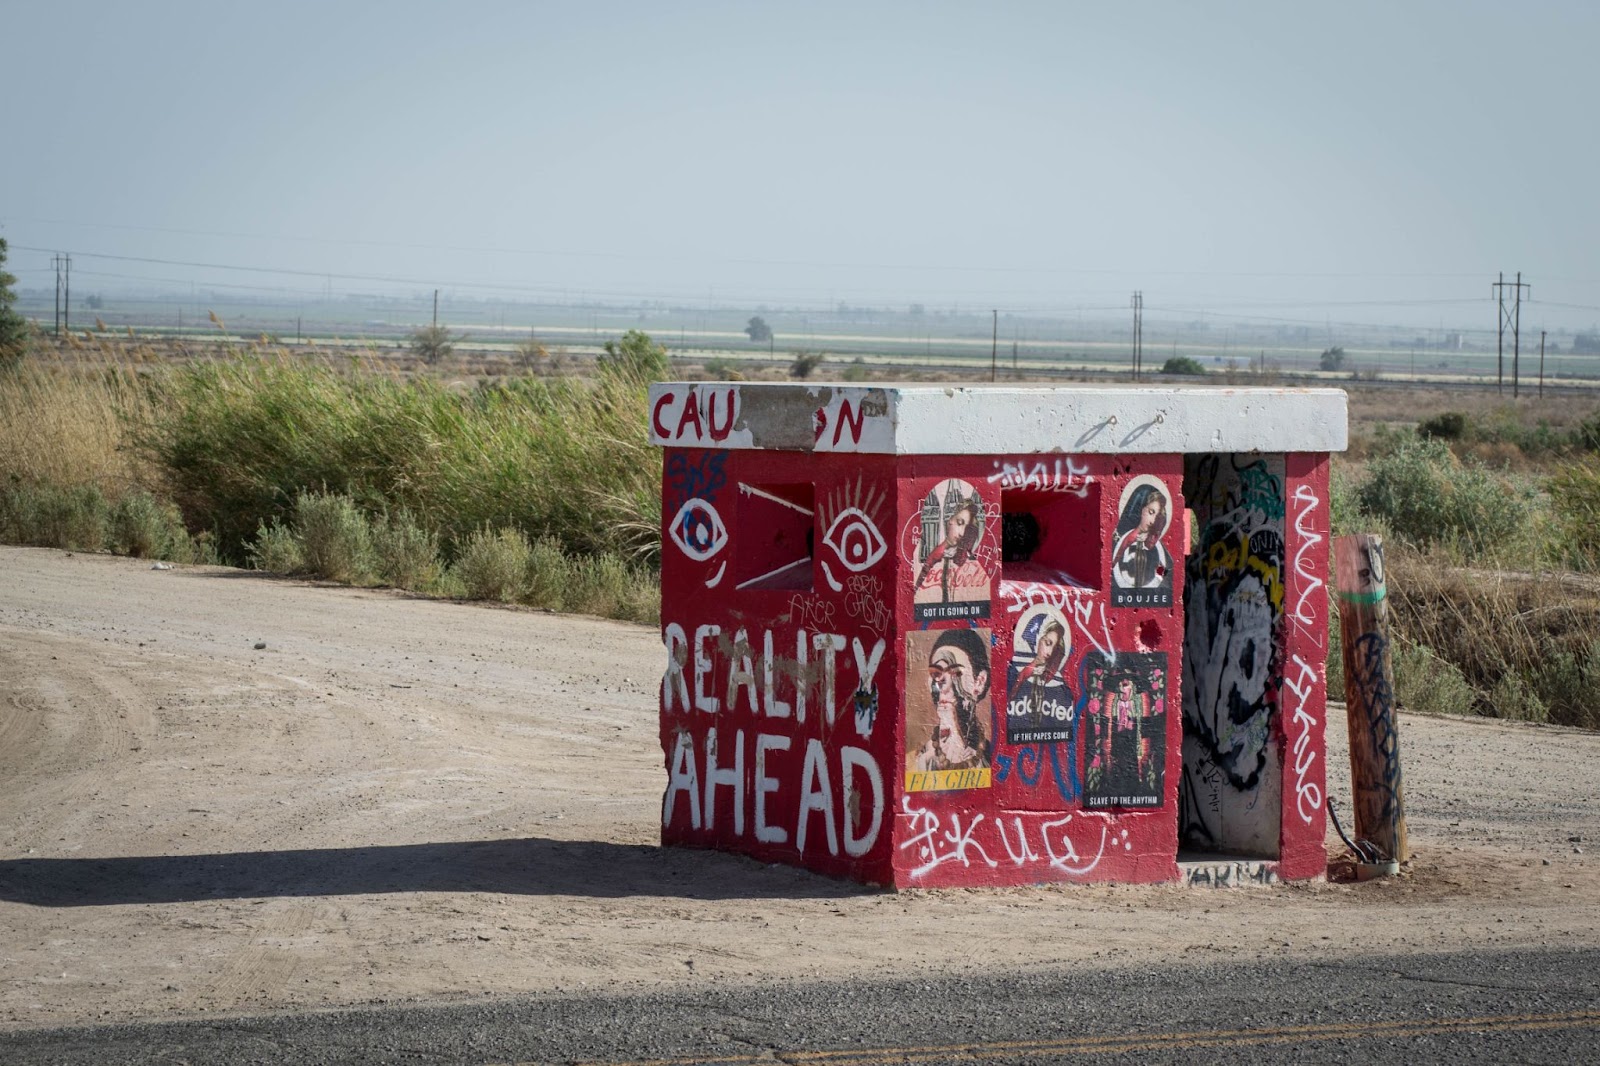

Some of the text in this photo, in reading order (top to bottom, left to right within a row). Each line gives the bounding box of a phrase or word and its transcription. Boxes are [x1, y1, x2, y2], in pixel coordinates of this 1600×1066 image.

[1117, 594, 1168, 603] BOUJEE
[923, 606, 981, 617] GOT IT GOING ON
[663, 622, 886, 739] REALITY
[1013, 731, 1069, 741] IF THE PAPES COME
[945, 769, 986, 789] GIRL
[663, 727, 885, 858] AHEAD
[1089, 795, 1158, 805] SLAVE TO THE RHYTHM
